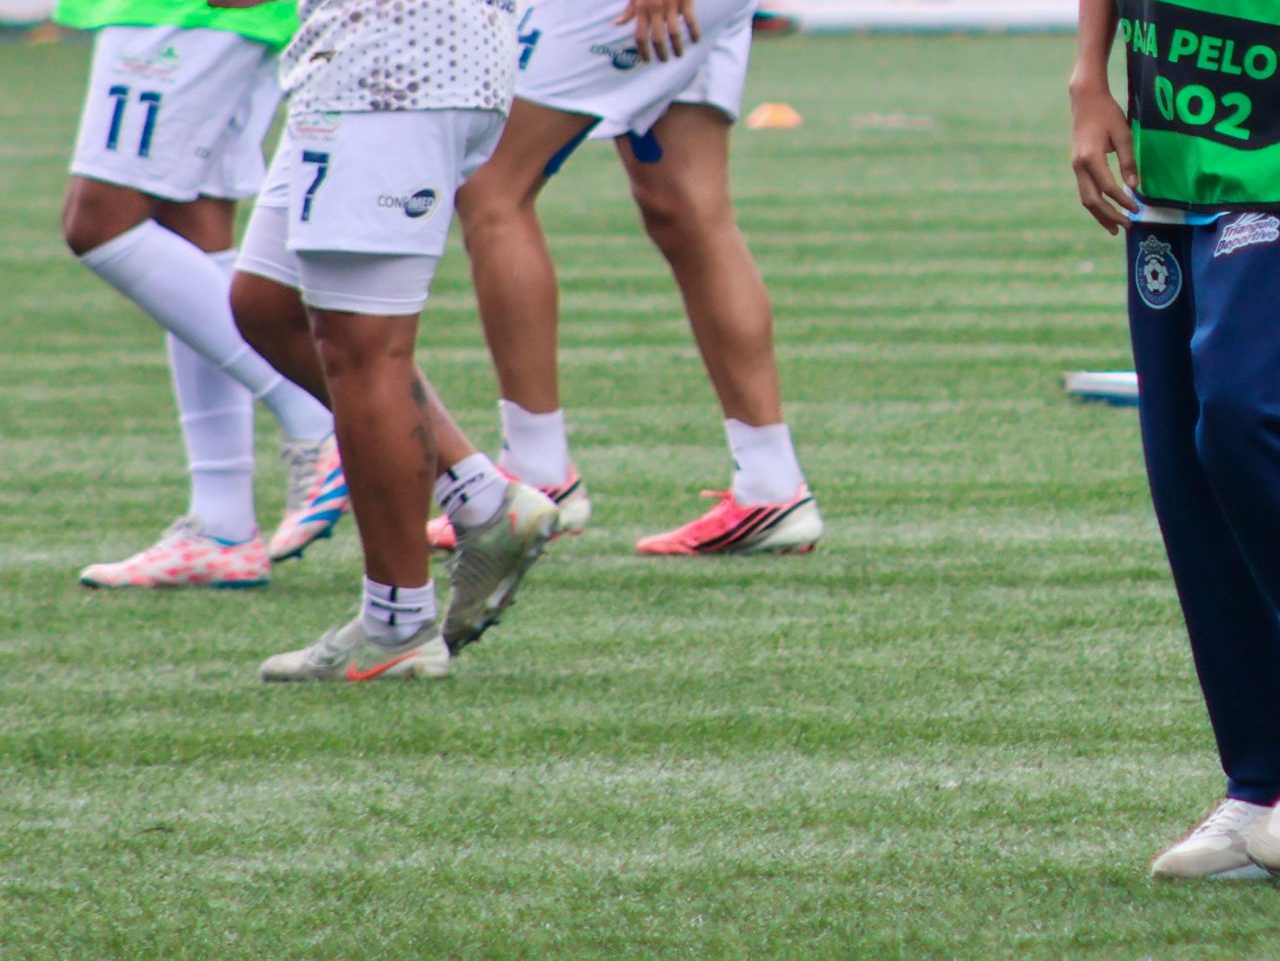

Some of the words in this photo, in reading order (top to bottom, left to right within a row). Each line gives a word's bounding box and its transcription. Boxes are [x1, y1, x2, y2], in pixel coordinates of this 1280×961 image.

[106, 85, 162, 158] 11
[1154, 75, 1252, 140] 002
[301, 150, 329, 221] 7
